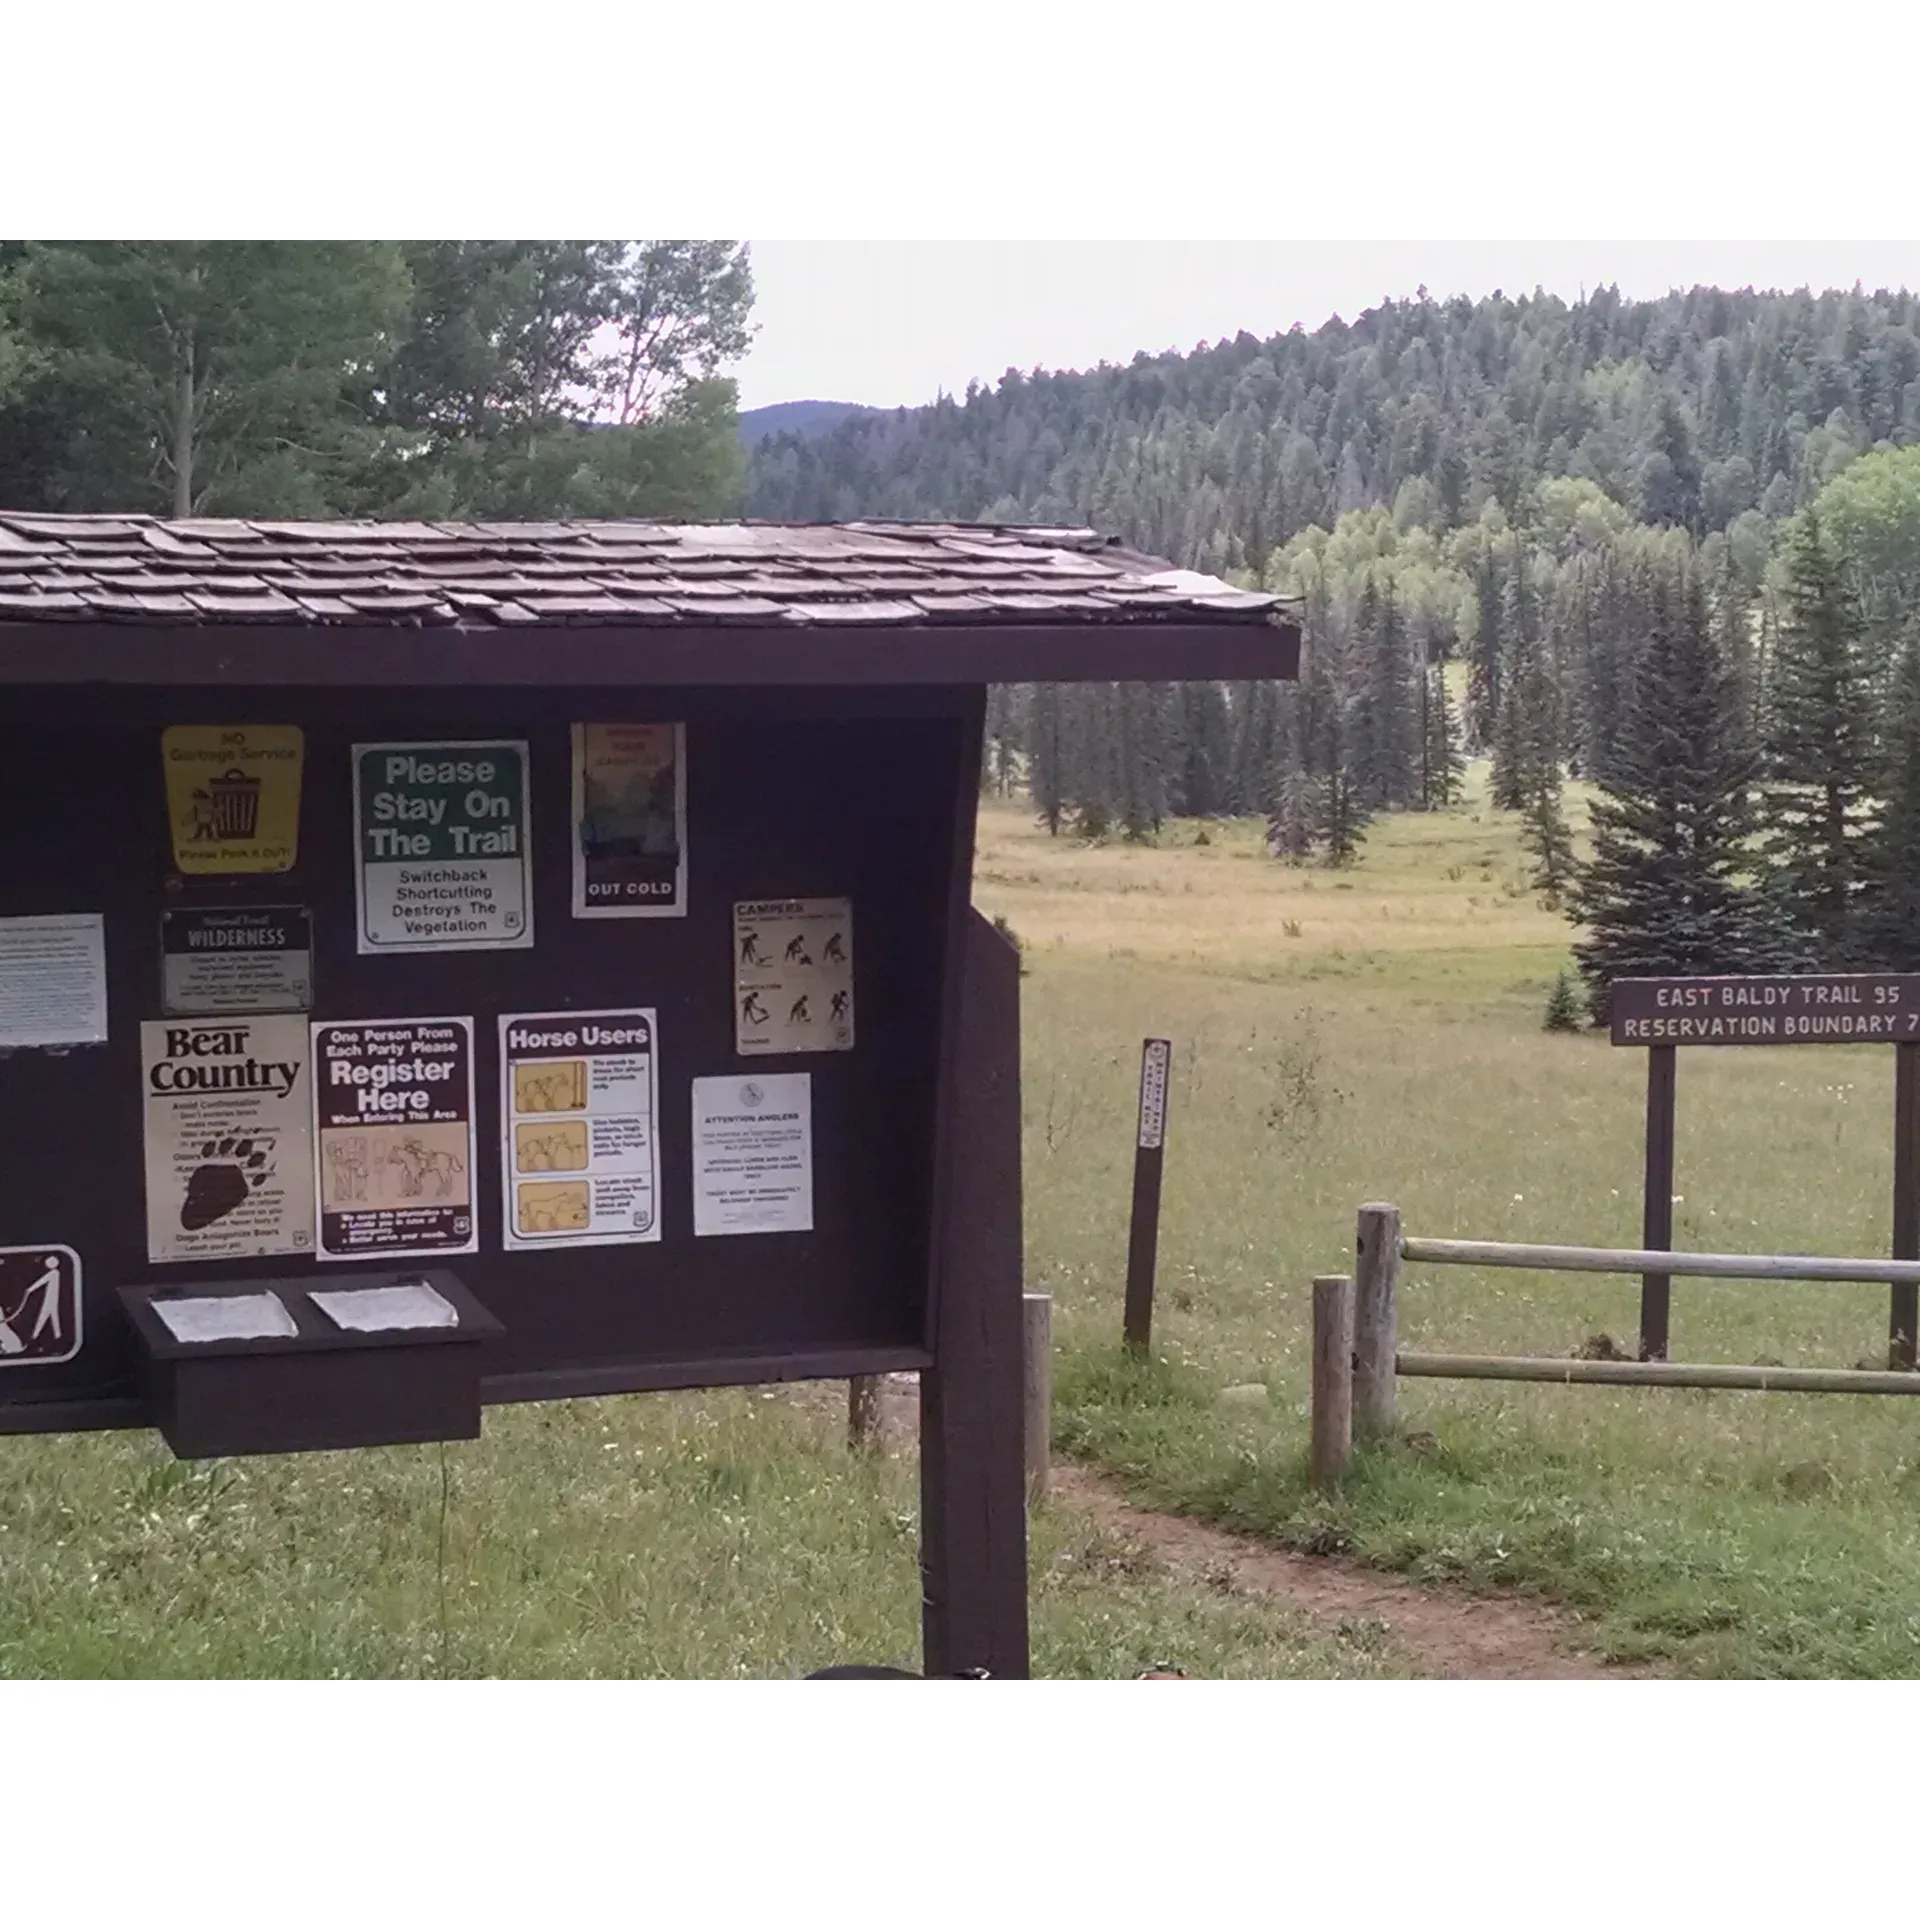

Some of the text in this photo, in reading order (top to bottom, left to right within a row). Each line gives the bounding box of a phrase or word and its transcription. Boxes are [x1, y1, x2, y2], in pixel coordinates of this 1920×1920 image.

[221, 732, 245, 745] NO
[386, 756, 496, 784] Please
[373, 789, 511, 825] Stay On
[368, 825, 517, 856] The Trail
[400, 869, 488, 884] Switchback
[396, 885, 492, 900] Shortcutting
[588, 882, 672, 896] OUT COLD
[392, 902, 497, 918] Destroys The
[405, 919, 487, 935] Vegetation
[188, 928, 286, 947] WILDERNESS
[1656, 985, 1901, 1007] EAST BALDY TRAIL 95
[330, 1027, 453, 1043] One Person From
[1625, 1014, 1919, 1037] RESERVATION BOUNDARY 7
[166, 1028, 250, 1058] Bear
[509, 1026, 648, 1049] Horse Users
[326, 1041, 458, 1057] Each Party Please
[150, 1058, 301, 1098] Country
[330, 1058, 455, 1088] Register
[358, 1087, 430, 1112] Here
[331, 1109, 457, 1124] When Entering This Area
[705, 1113, 799, 1125] ATTENTION ANGLERS
